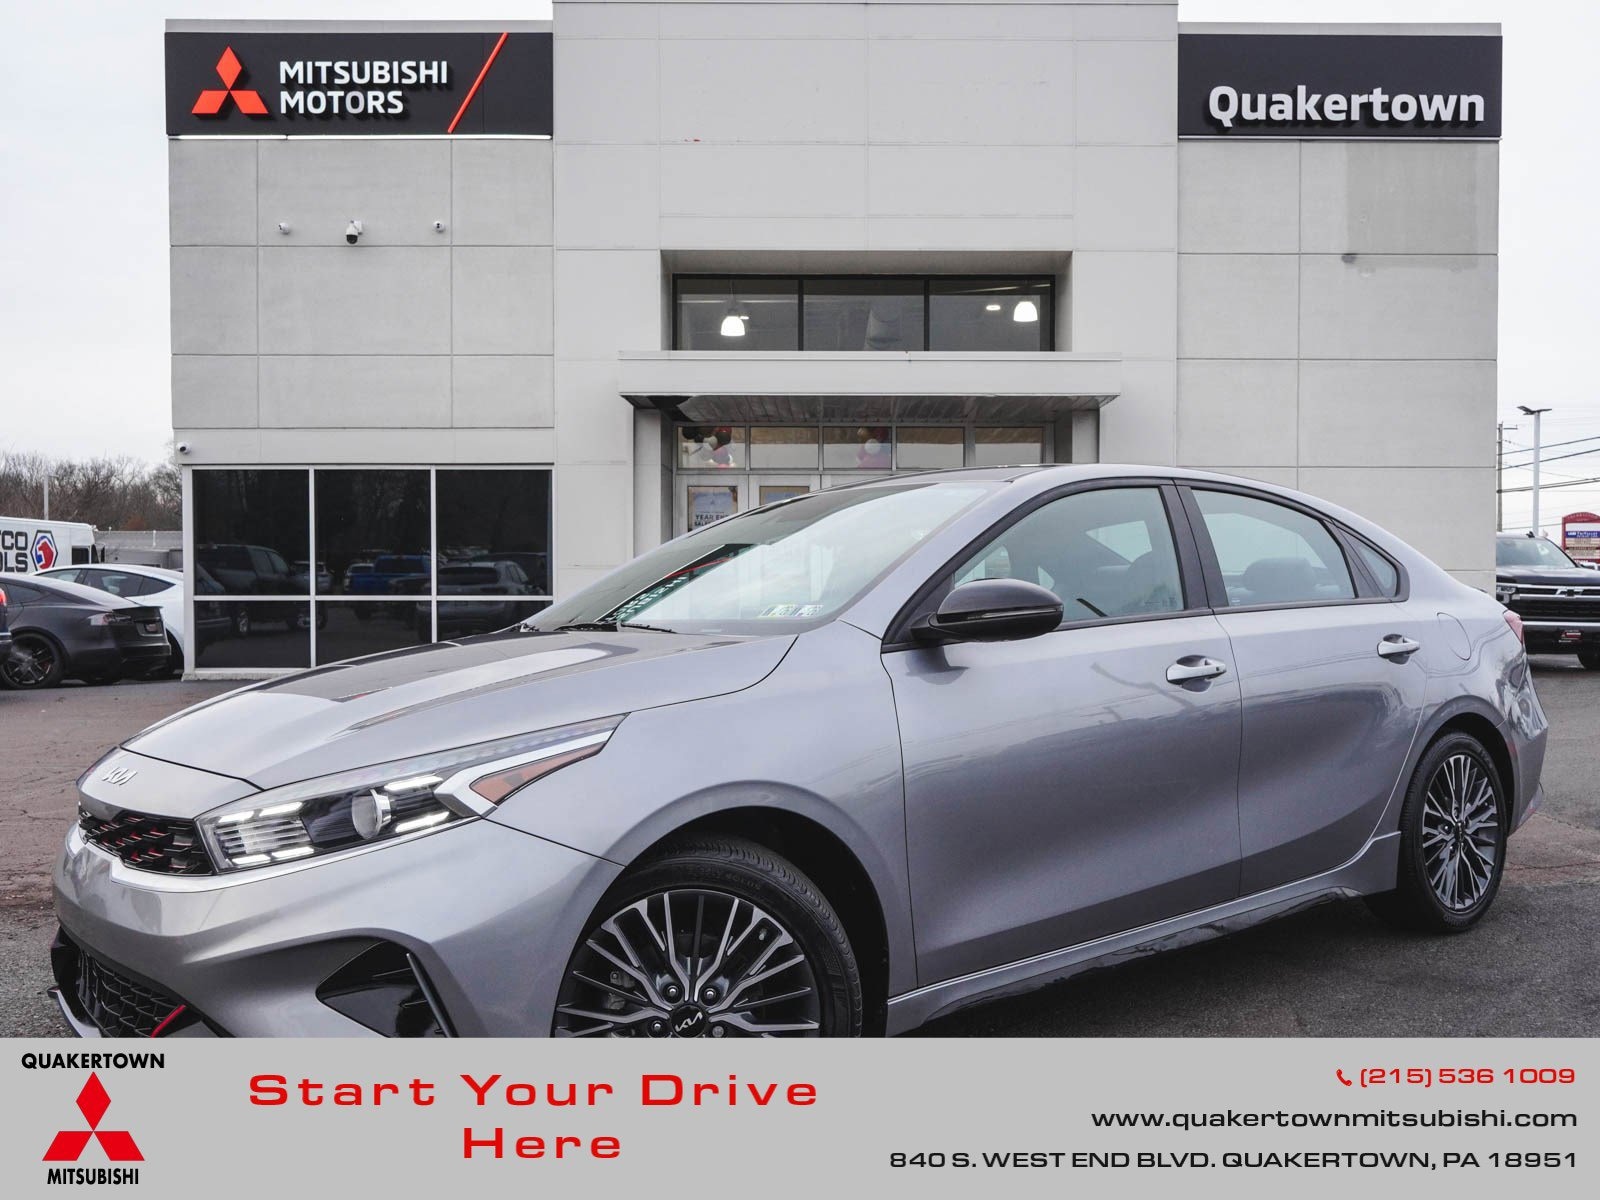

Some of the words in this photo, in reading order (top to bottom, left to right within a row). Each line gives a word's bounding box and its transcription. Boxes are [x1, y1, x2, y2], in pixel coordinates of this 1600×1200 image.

[279, 60, 448, 85] MITSUBISHI
[279, 90, 404, 114] MOTORS
[1208, 84, 1486, 127] Quakertown
[0, 530, 28, 551] CO
